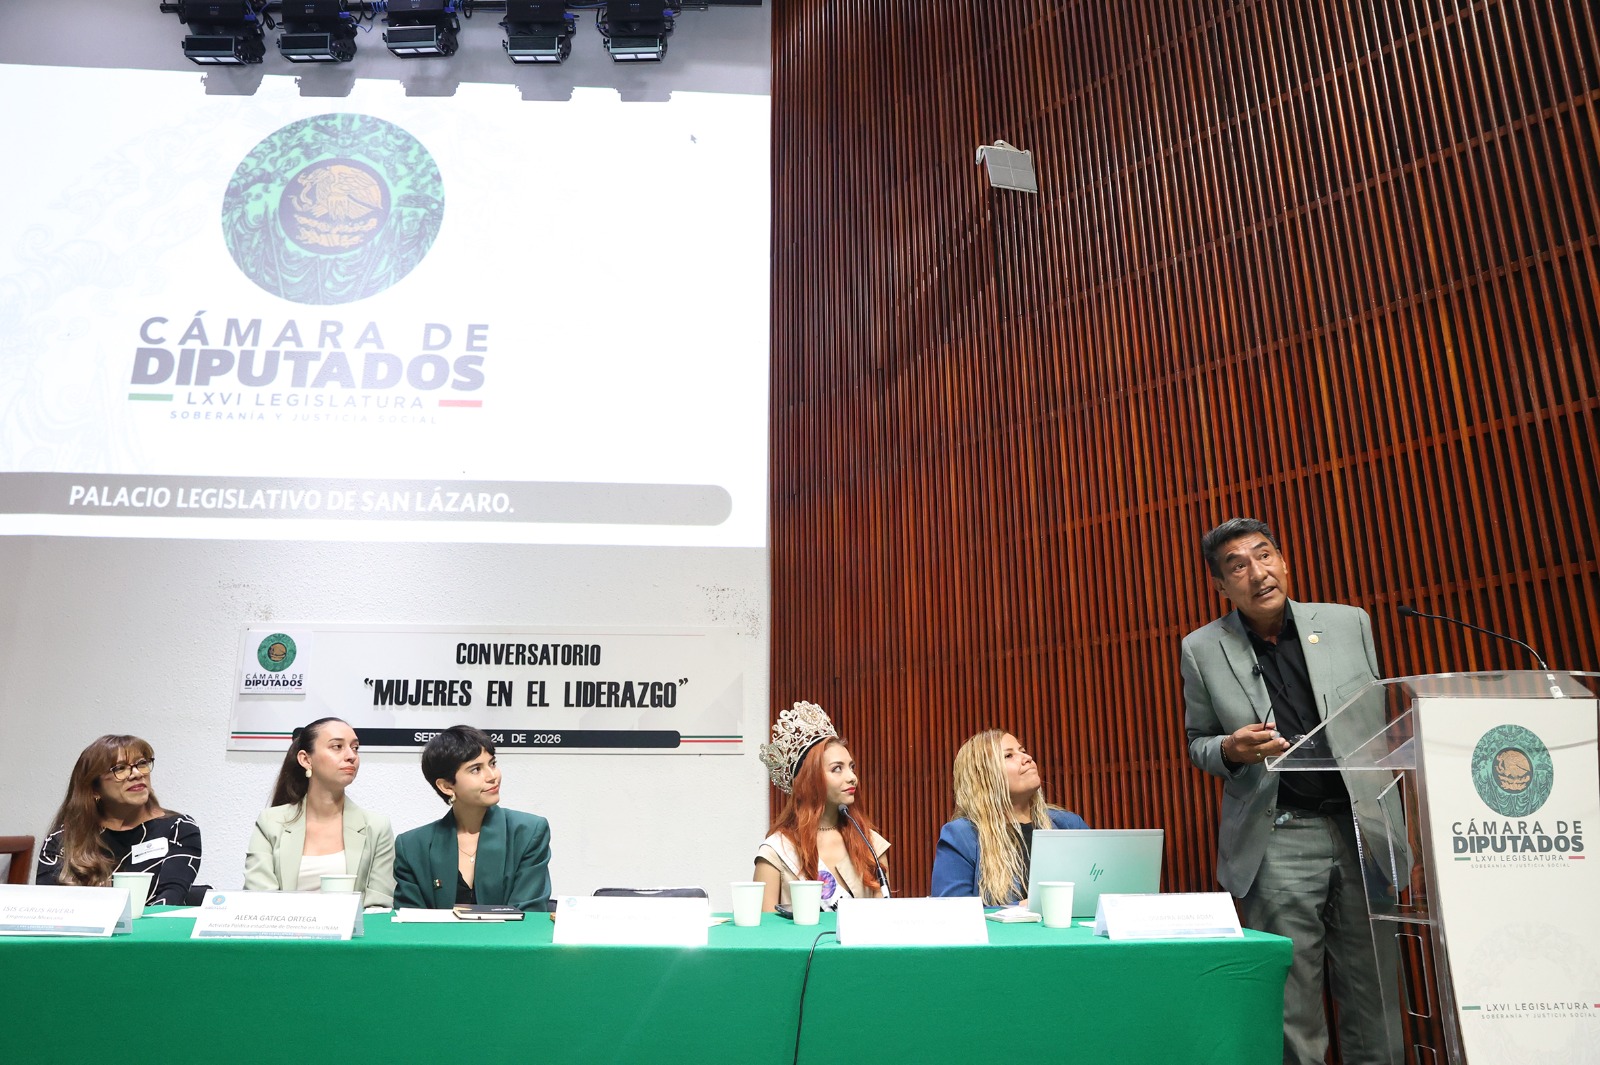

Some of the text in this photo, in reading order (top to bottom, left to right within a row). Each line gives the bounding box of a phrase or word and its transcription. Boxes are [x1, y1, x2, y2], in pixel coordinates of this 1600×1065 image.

[139, 311, 490, 353] CÁMARA DE
[130, 346, 486, 391] DIPUTADOS
[186, 391, 424, 409] LXVI LEGISLATURA
[169, 409, 438, 425] SOBERANÍA Y JUSTICIA SOCIAL
[69, 484, 515, 514] PALACIO LEGISLATIVO DE SAN LÁZARO.
[455, 642, 602, 667] CONVERSATORIO
[486, 681, 513, 708] EN
[527, 681, 550, 708] EL
[490, 733, 562, 744] 24 DE 2026
[1452, 818, 1583, 835] CÁMARA DE
[1452, 835, 1585, 854] DIPUTADOS
[234, 914, 258, 922] ALEXA
[287, 916, 318, 924] ORTEGA
[1486, 1002, 1589, 1011] LXVI LEGISLATURA
